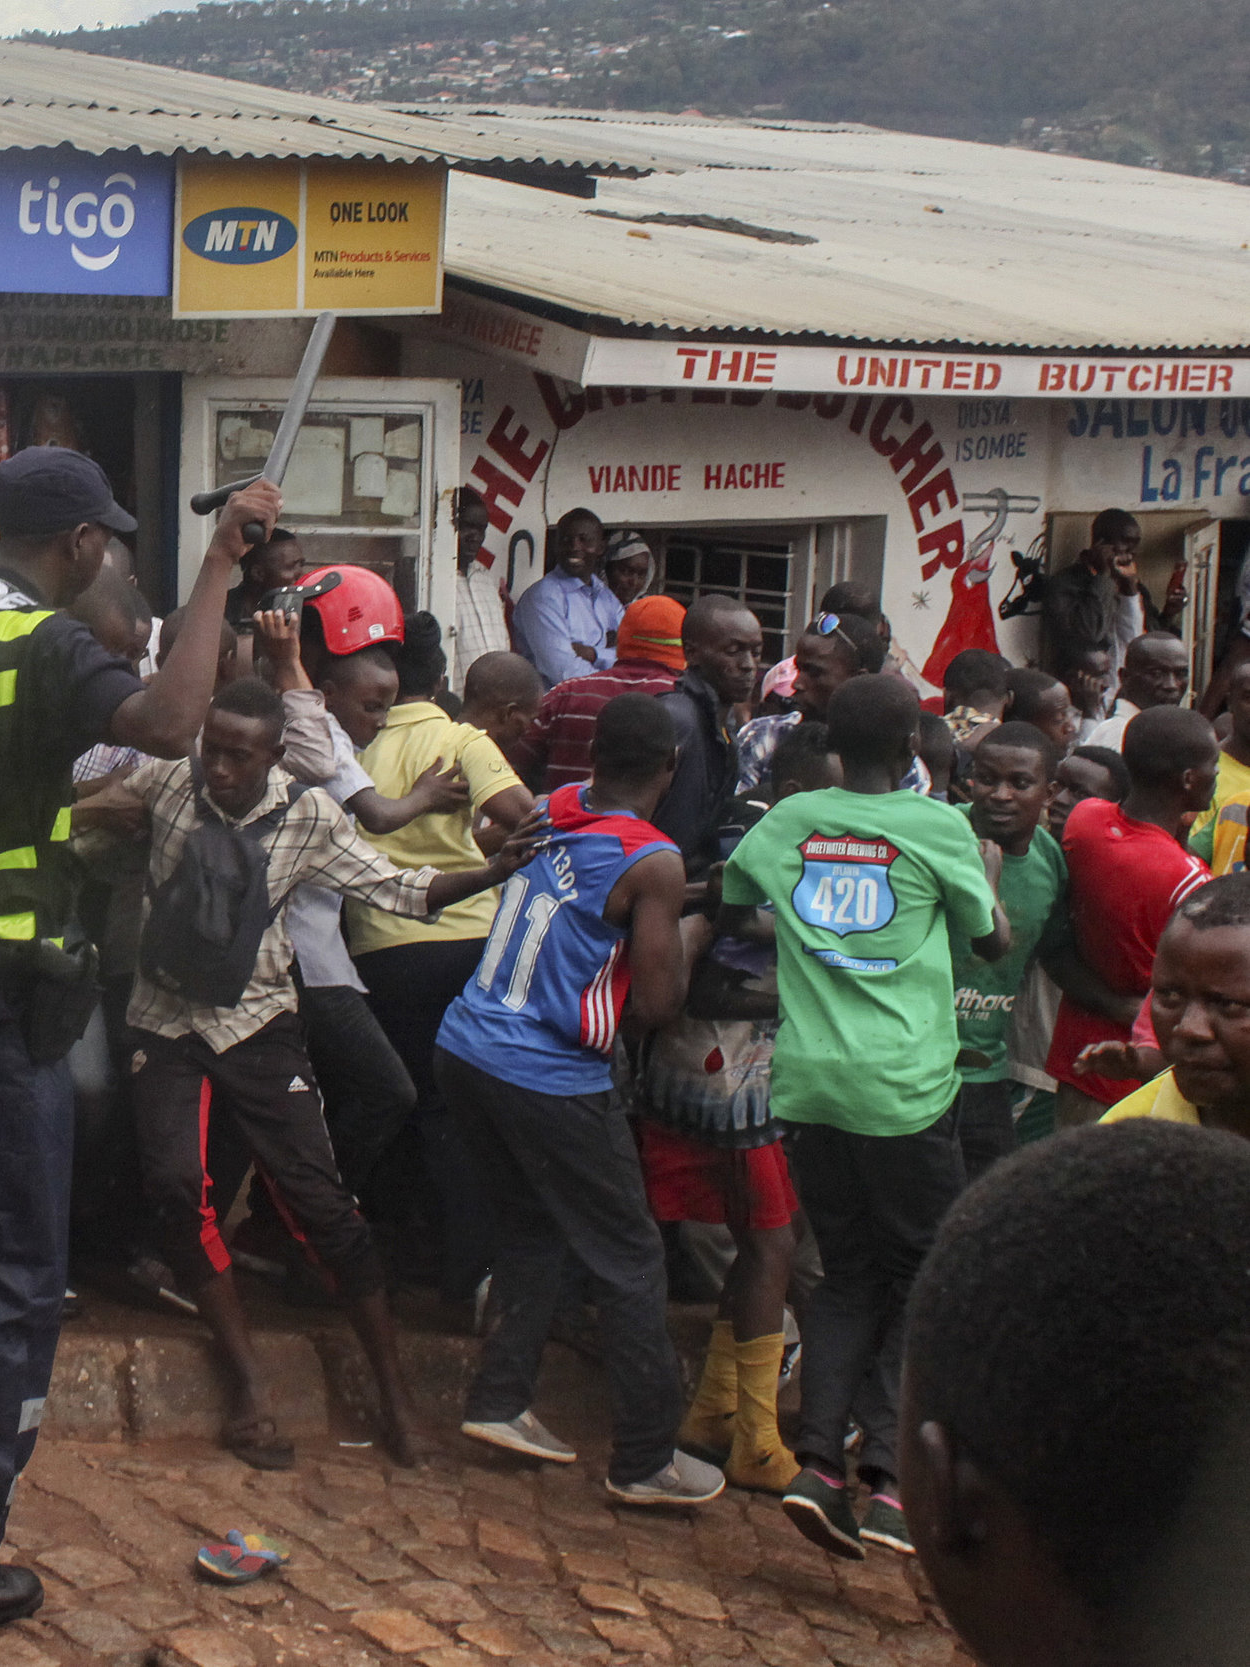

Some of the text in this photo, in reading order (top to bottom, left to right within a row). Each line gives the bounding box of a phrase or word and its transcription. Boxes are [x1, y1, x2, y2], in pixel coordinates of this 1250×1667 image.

[330, 202, 409, 224] ONE LOOK
[204, 220, 279, 252] MTN
[314, 250, 431, 263] MTN Products & Services
[313, 268, 375, 278] Available Here
[677, 348, 1234, 392] THE UNITED BUTCHER
[955, 432, 1027, 461] ISOMBE
[463, 404, 550, 570] HE
[588, 462, 786, 493] VIANDE HACHE
[1141, 445, 1182, 503] La
[806, 841, 847, 856] SWEETWATER
[846, 843, 877, 858] BREWING
[810, 877, 879, 926] 420
[477, 871, 561, 1012] 11
